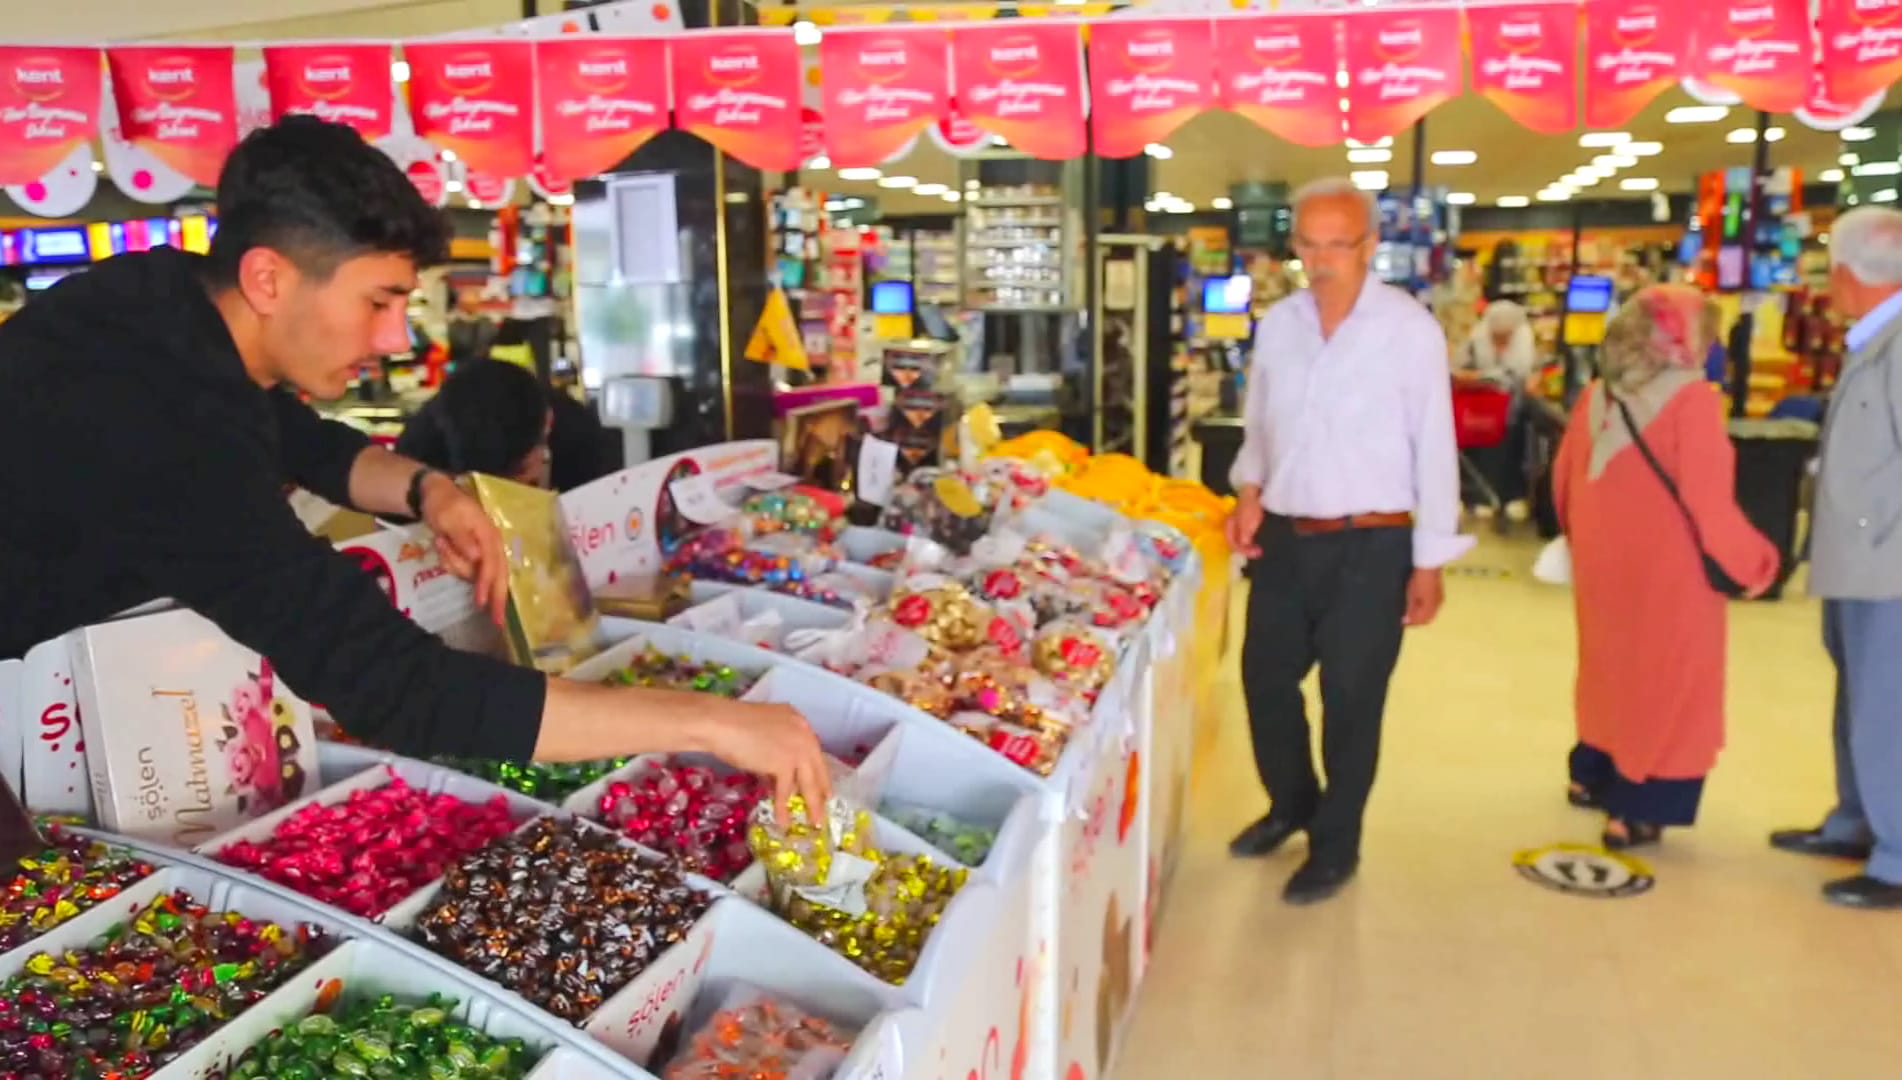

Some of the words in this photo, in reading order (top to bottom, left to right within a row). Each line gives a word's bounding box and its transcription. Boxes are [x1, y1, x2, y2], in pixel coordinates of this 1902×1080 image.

[445, 62, 492, 78] kent
[578, 60, 627, 76] kent
[711, 55, 758, 70] kent
[15, 68, 63, 83] kent
[148, 68, 194, 83] kent
[304, 66, 351, 82] kent
